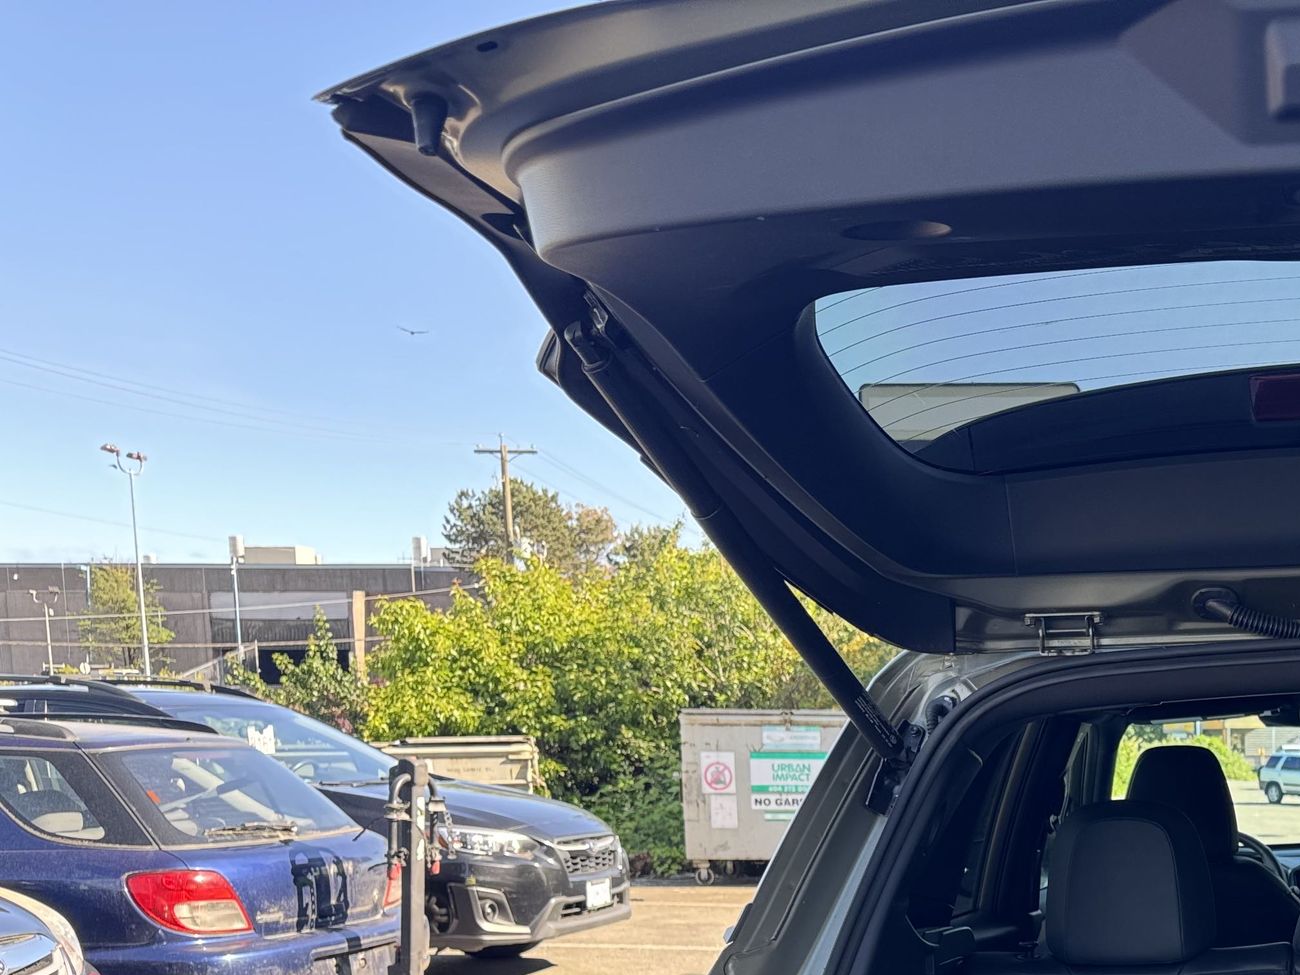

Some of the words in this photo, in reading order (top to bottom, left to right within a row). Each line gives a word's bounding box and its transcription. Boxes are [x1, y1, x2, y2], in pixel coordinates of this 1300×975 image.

[771, 763, 811, 773] URBAN
[772, 773, 811, 782] IMPACT
[754, 798, 772, 806] NO
